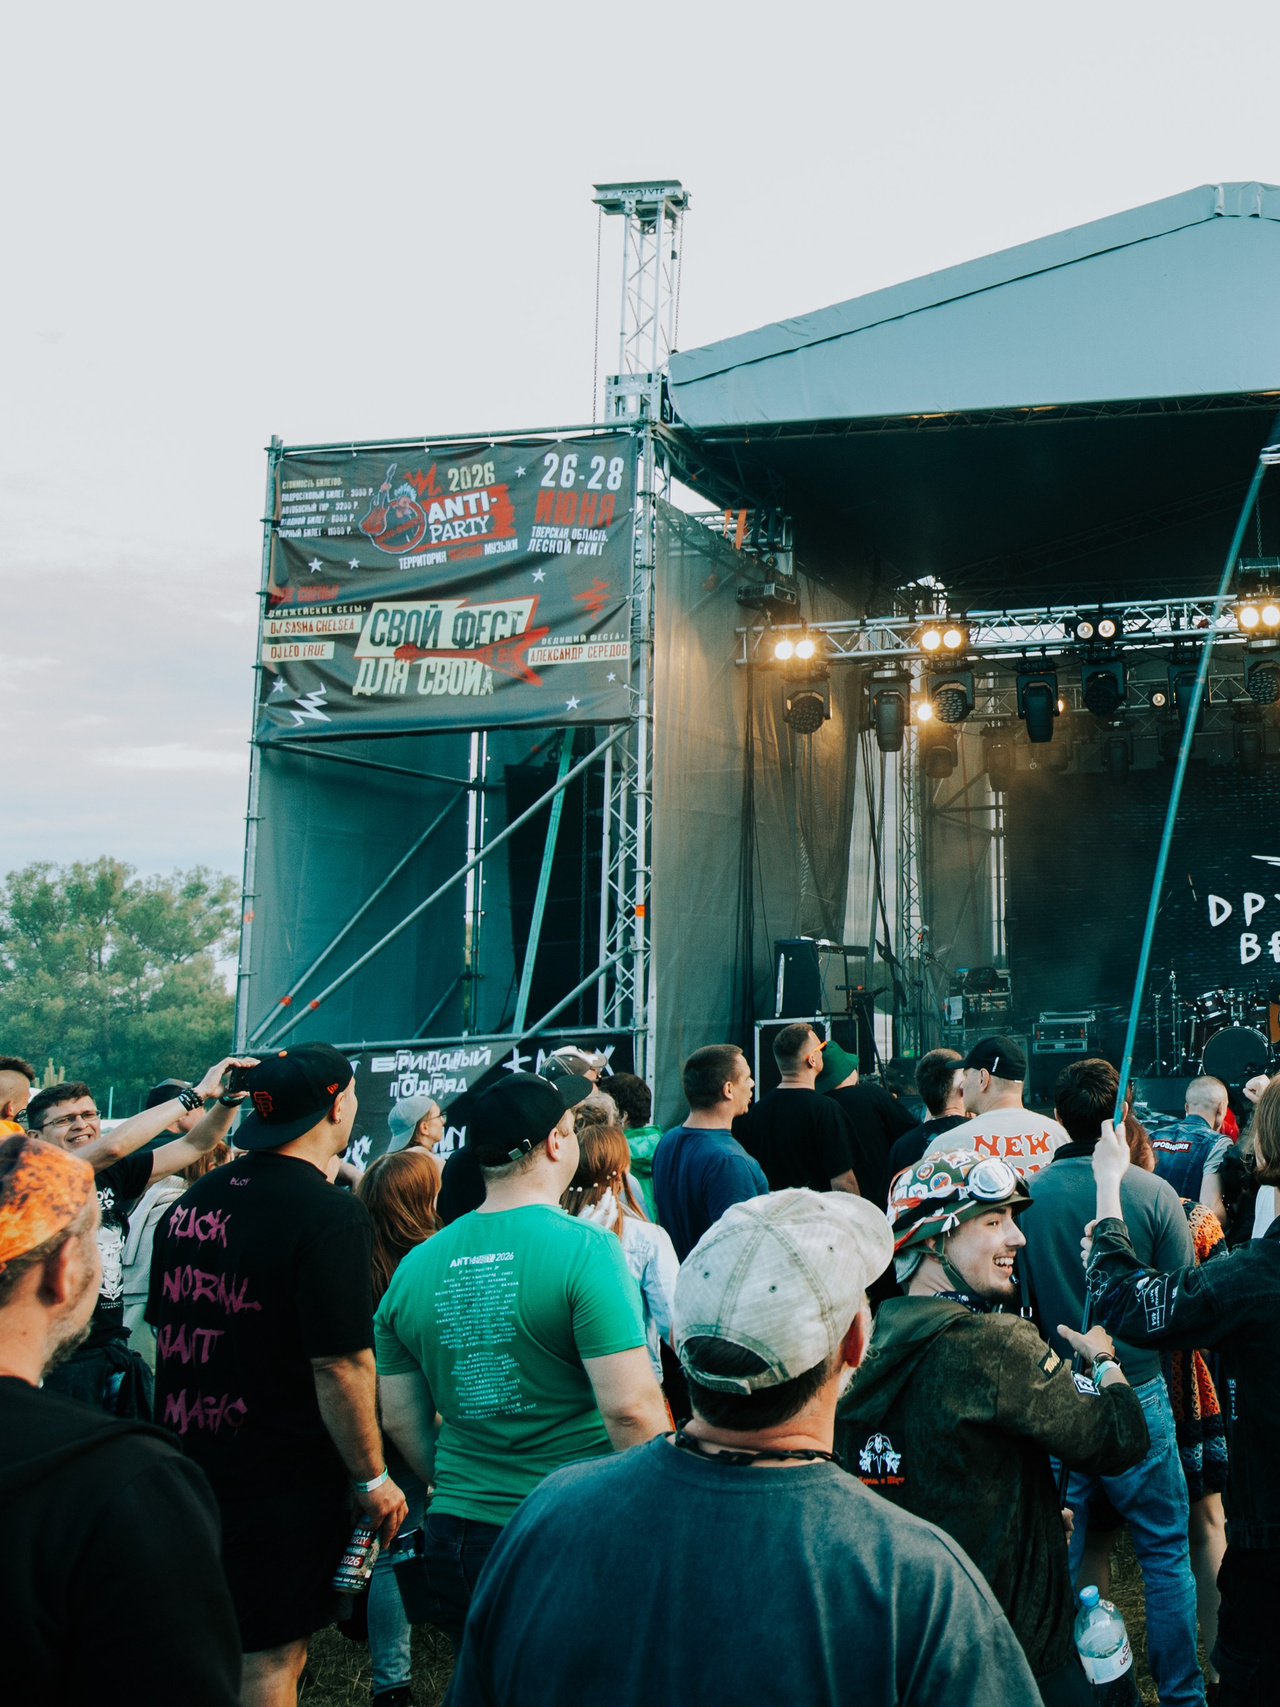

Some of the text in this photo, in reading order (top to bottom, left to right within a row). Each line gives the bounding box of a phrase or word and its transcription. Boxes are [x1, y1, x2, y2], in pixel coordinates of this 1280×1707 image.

[447, 460, 496, 492] 2026
[534, 489, 616, 528] ИЮНЯ
[429, 514, 491, 544] PARTY
[531, 525, 570, 539] ТВЕРСКАЯ
[398, 551, 447, 570] ТЕРРИТОРИЯ
[484, 538, 518, 556] МУЗЫКИ
[527, 538, 605, 556] ЛЕСНОЙ СКИТ
[268, 606, 333, 618] ДИДЖЕЙСКИЕ
[270, 618, 354, 635] DJ SASHA CHELSEA
[369, 604, 524, 649] СВОЙ ФЕСТ
[541, 633, 587, 645] ВЕДУЩИЙ
[270, 643, 326, 659] DJ LEO TRUE
[530, 646, 583, 663] АЛЕКСАНДР
[352, 658, 494, 697] ДЛЯ СВОИХ
[371, 1046, 492, 1073] БРИГАДНЫЙ
[389, 1073, 468, 1099] ПОДРЯД
[972, 1130, 1051, 1158] NEW
